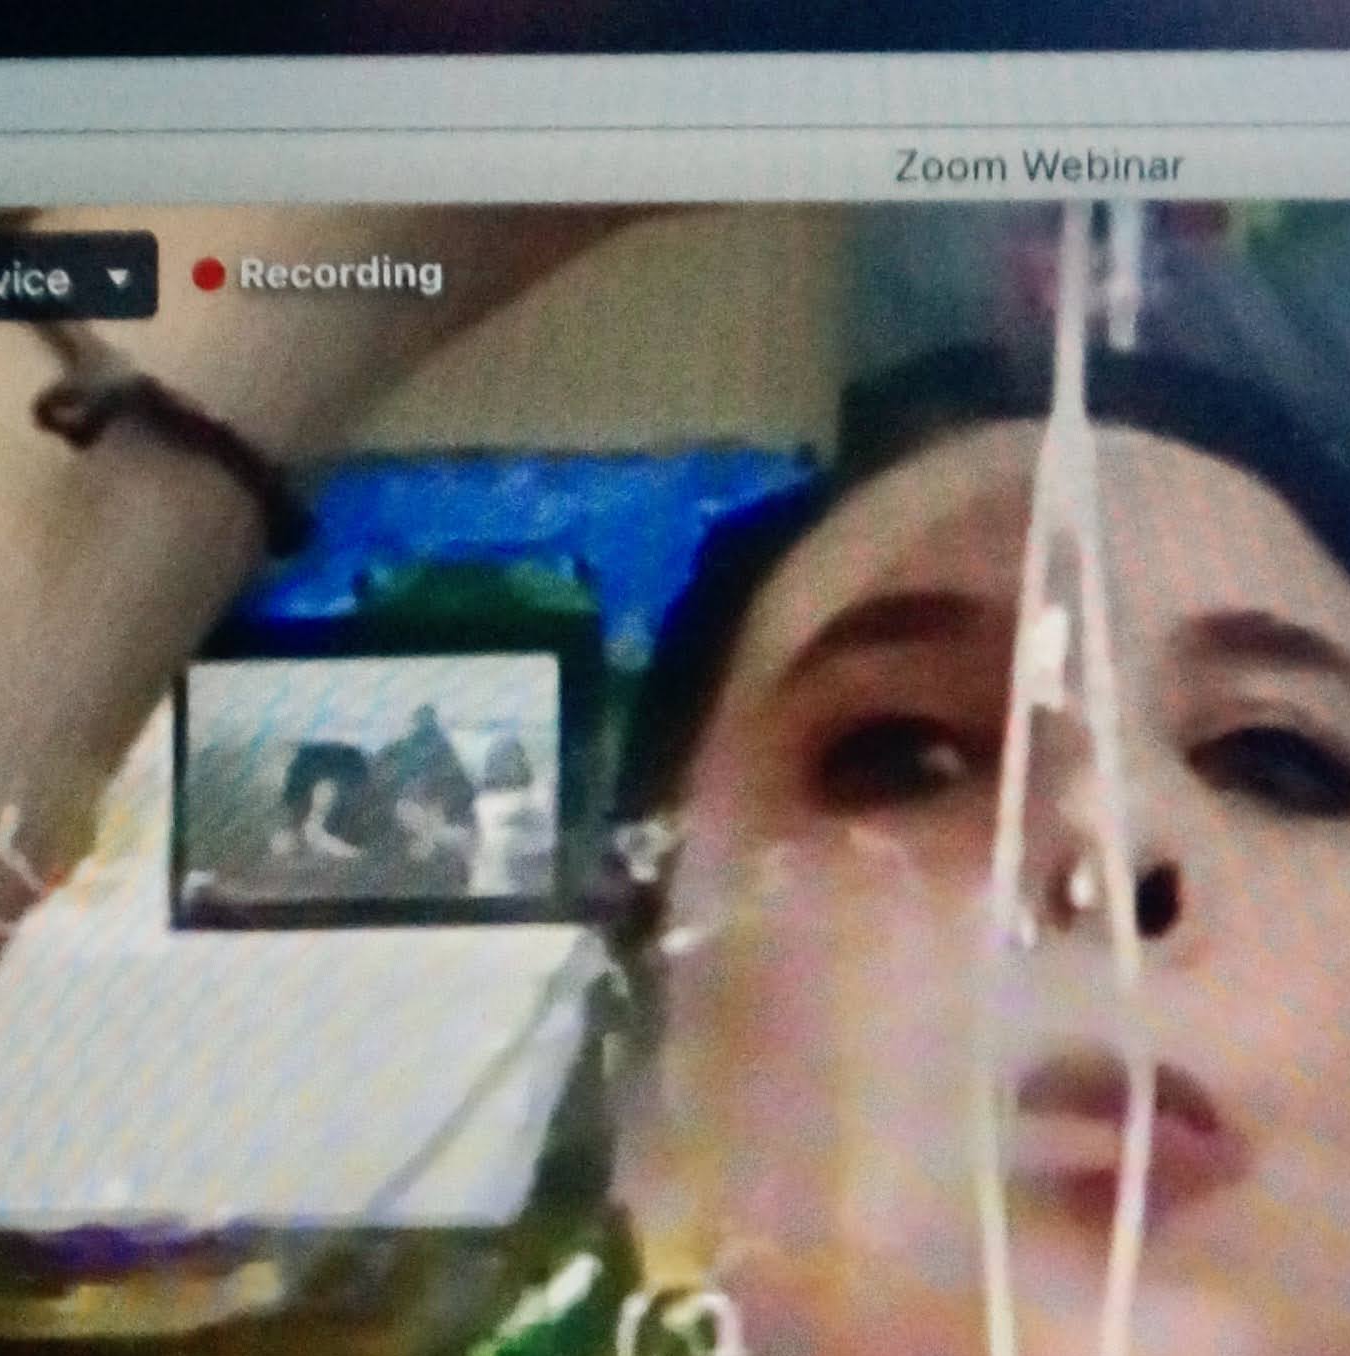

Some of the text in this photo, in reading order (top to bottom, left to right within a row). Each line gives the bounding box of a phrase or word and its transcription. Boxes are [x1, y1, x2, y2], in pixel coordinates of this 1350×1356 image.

[896, 148, 1183, 183] Zoom Webinar
[240, 256, 444, 293] Recording
